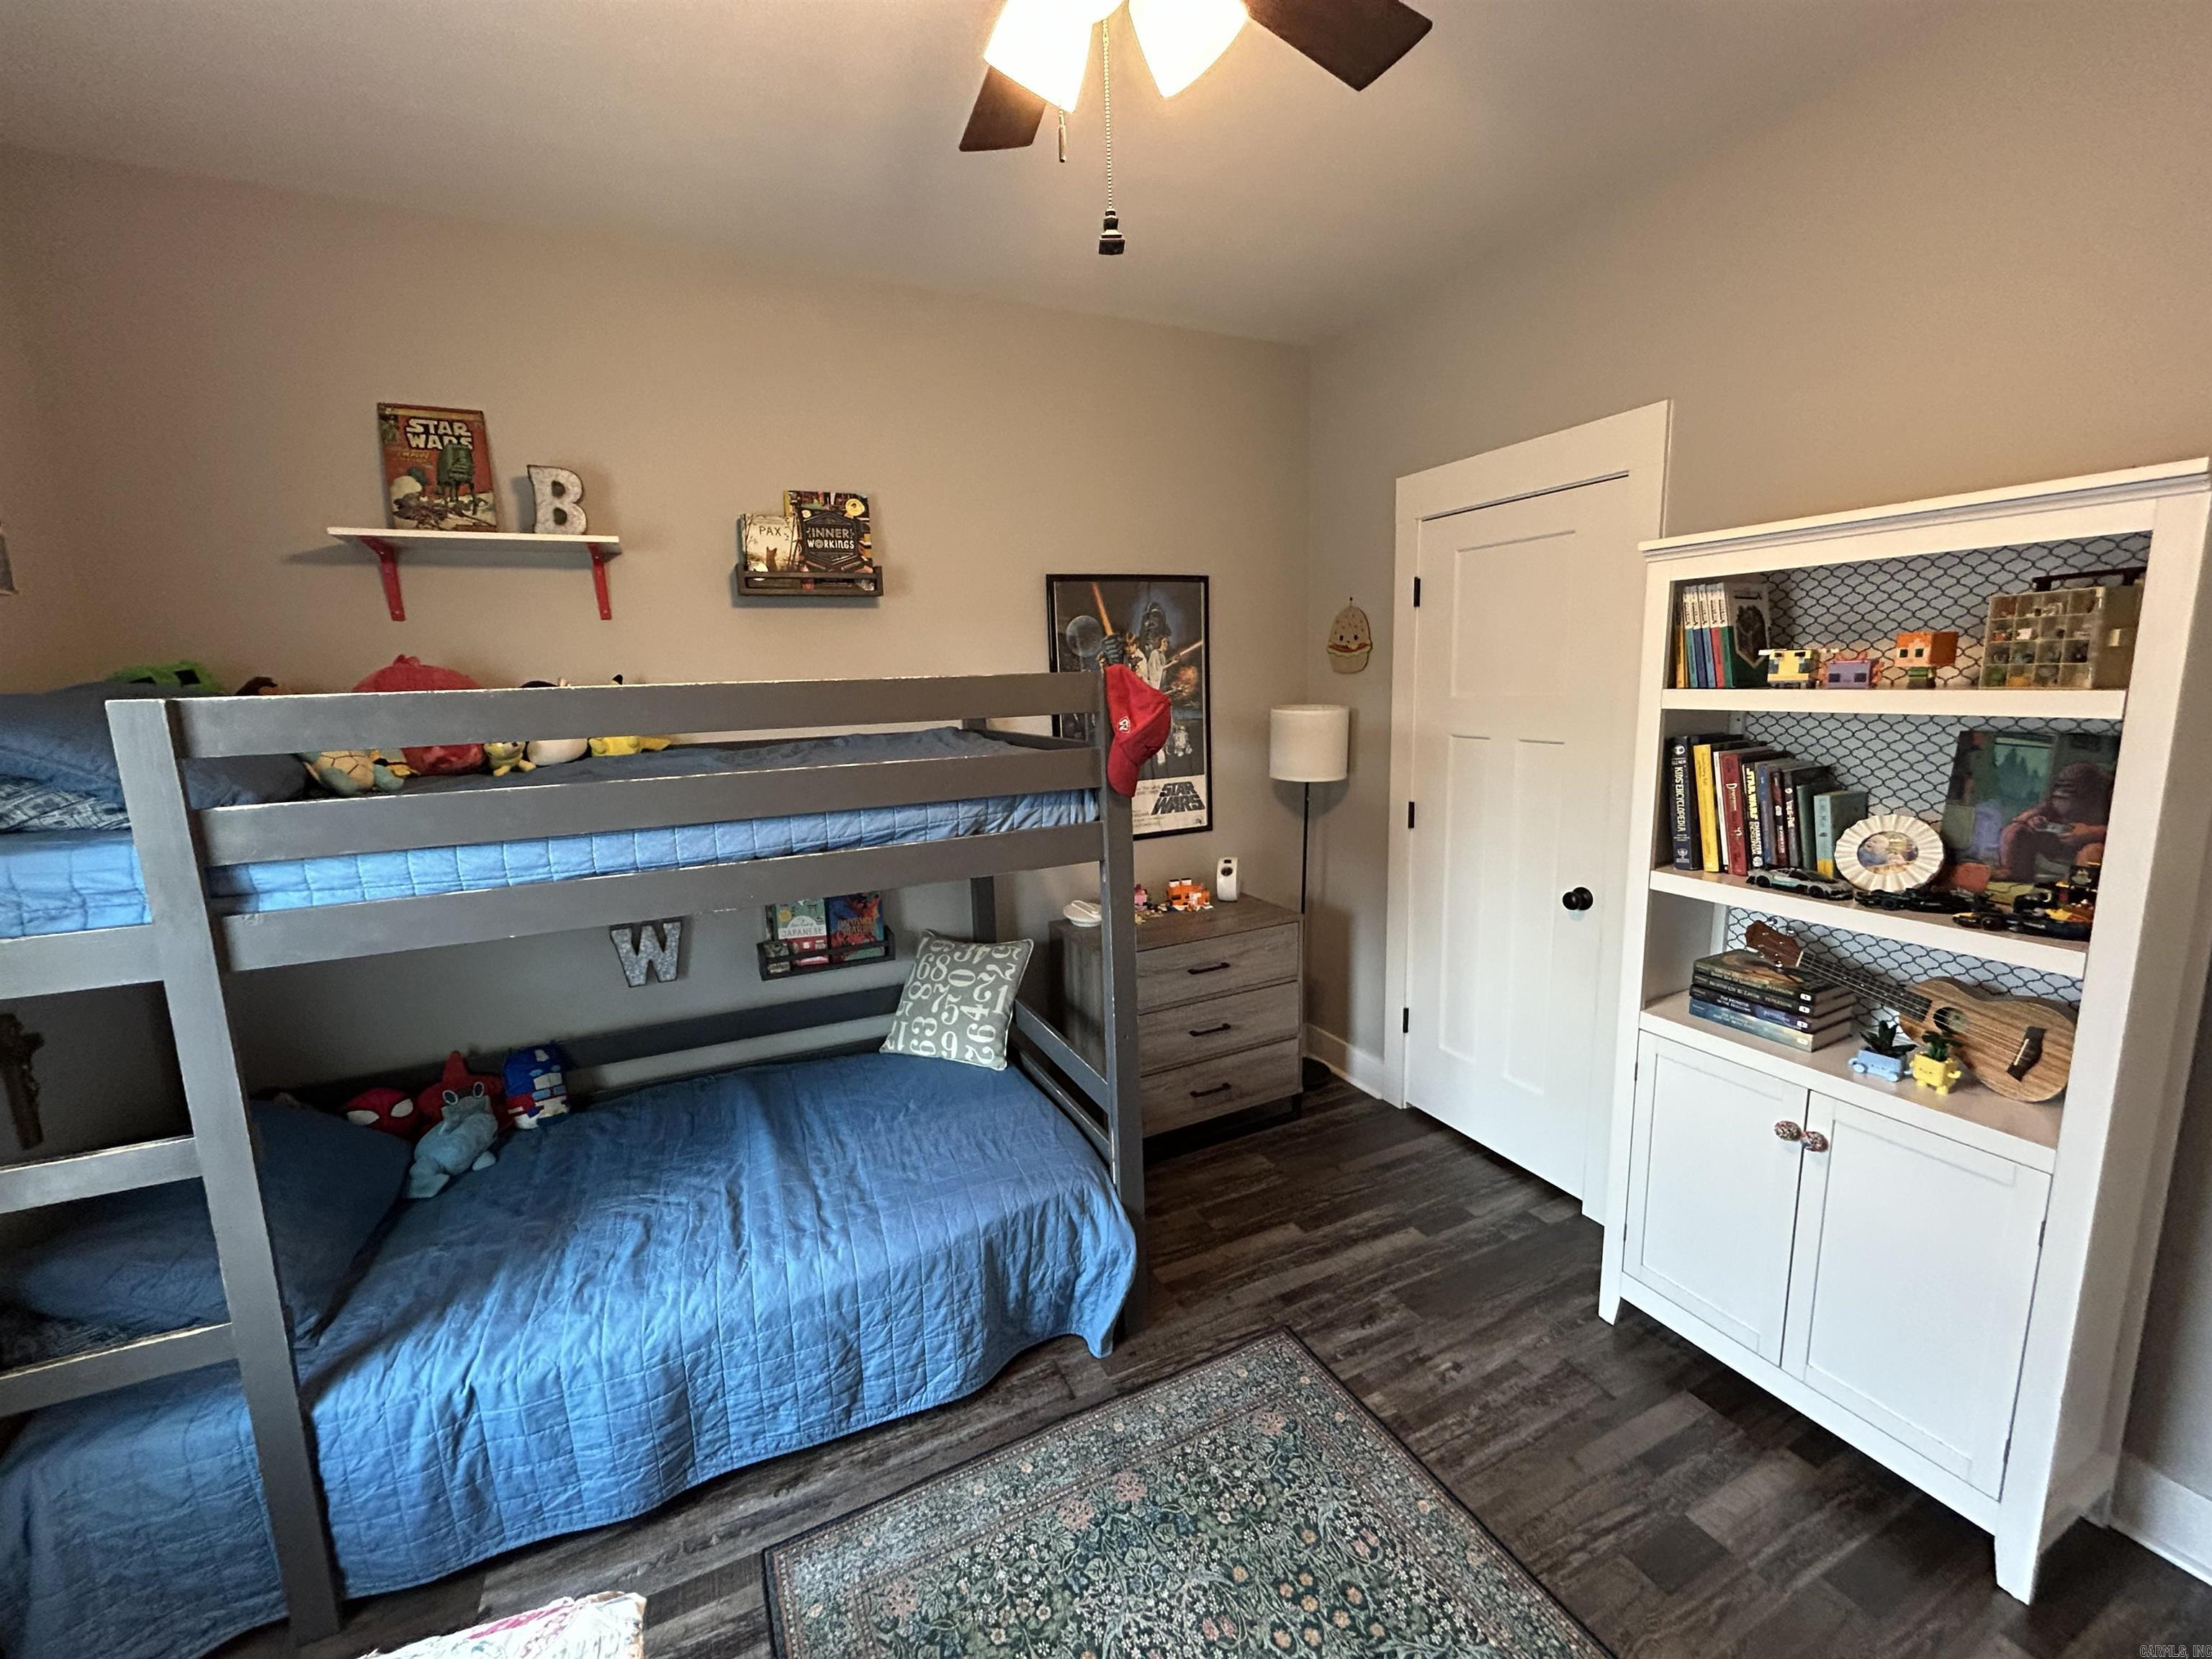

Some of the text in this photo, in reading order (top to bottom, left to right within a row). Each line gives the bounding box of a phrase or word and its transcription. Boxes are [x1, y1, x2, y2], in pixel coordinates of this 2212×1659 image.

[406, 418, 472, 436] STAR
[527, 465, 587, 534] B
[759, 526, 781, 536] PAX
[1159, 781, 1197, 797] STAR
[1746, 768, 1758, 820] STAR WARS
[1151, 794, 1205, 815] WARS
[609, 916, 683, 987] W
